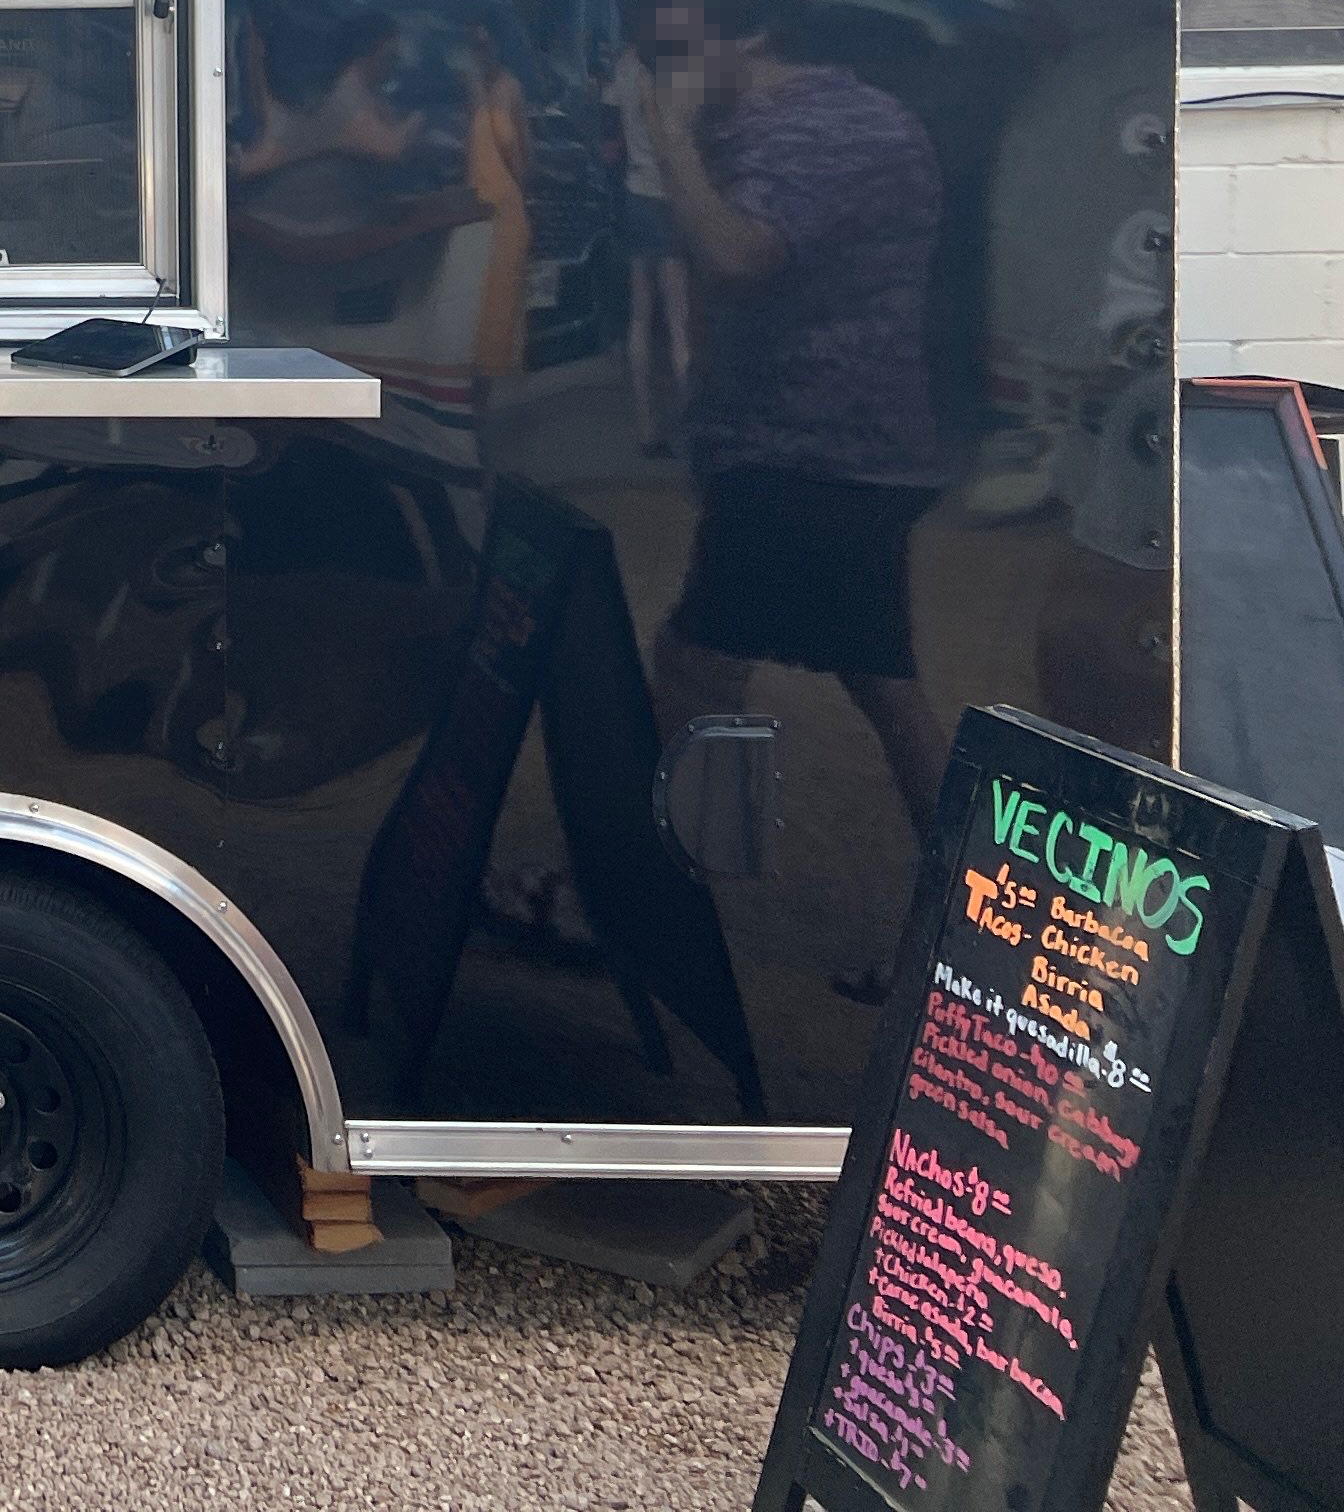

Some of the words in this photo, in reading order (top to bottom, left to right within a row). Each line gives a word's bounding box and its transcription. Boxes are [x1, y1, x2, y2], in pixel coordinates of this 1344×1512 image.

[993, 779, 1211, 955] VECINOS
[1041, 924, 1139, 985] Chicken
[1050, 896, 1149, 961] Barbacoa
[934, 961, 982, 1006] Make
[986, 987, 1004, 1016] it
[1021, 983, 1091, 1041] Asada
[1031, 955, 1103, 1011] Birria
[909, 1073, 956, 1112] green
[1047, 1124, 1122, 1182] cream
[885, 1166, 944, 1224] Refried
